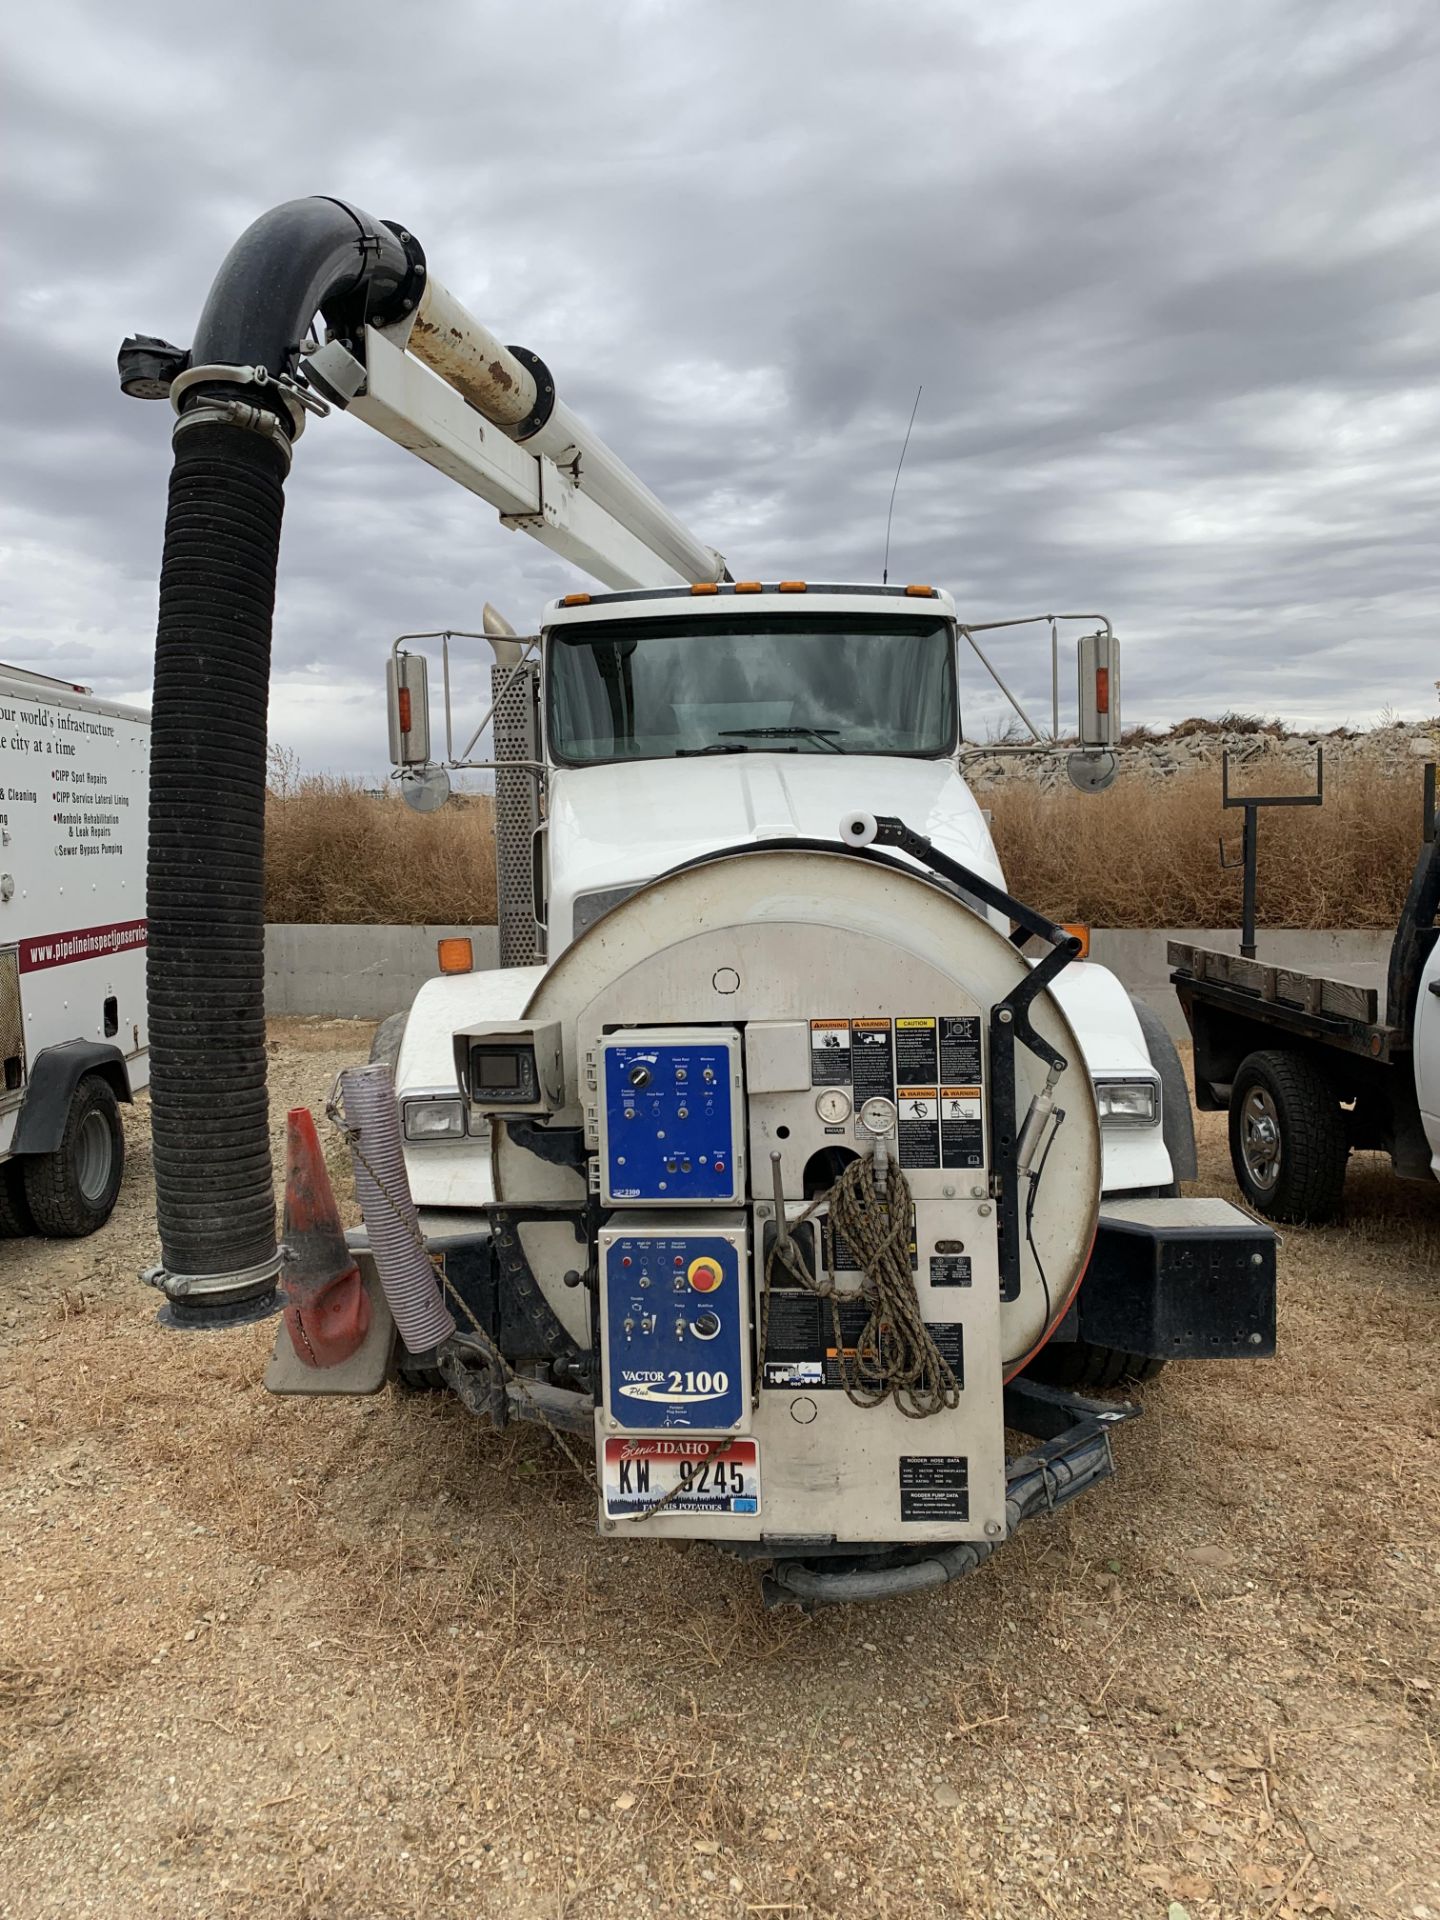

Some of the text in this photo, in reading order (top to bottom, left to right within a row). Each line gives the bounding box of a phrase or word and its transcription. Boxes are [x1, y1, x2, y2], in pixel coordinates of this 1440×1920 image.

[20, 708, 54, 728] world's
[57, 712, 115, 737] infrastructure
[11, 732, 30, 756] city
[34, 739, 42, 753] at
[46, 742, 52, 754] a
[55, 738, 76, 756] time
[55, 769, 107, 785] CIPP Spot Repairs
[8, 788, 37, 803] Cleaning
[56, 791, 129, 807] CIPP Service Lateral Lining
[57, 813, 119, 825] Manhole Rehabilitation
[68, 826, 111, 838] & Leak Repairs
[58, 843, 123, 857] Sewer Bypass Pumping
[621, 1370, 729, 1393] VACTOR 2100
[629, 1386, 649, 1396] Plus
[620, 1442, 710, 1459] Scenic IDAHO
[619, 1459, 744, 1494] KW 9245
[679, 1503, 722, 1511] POTATOES
